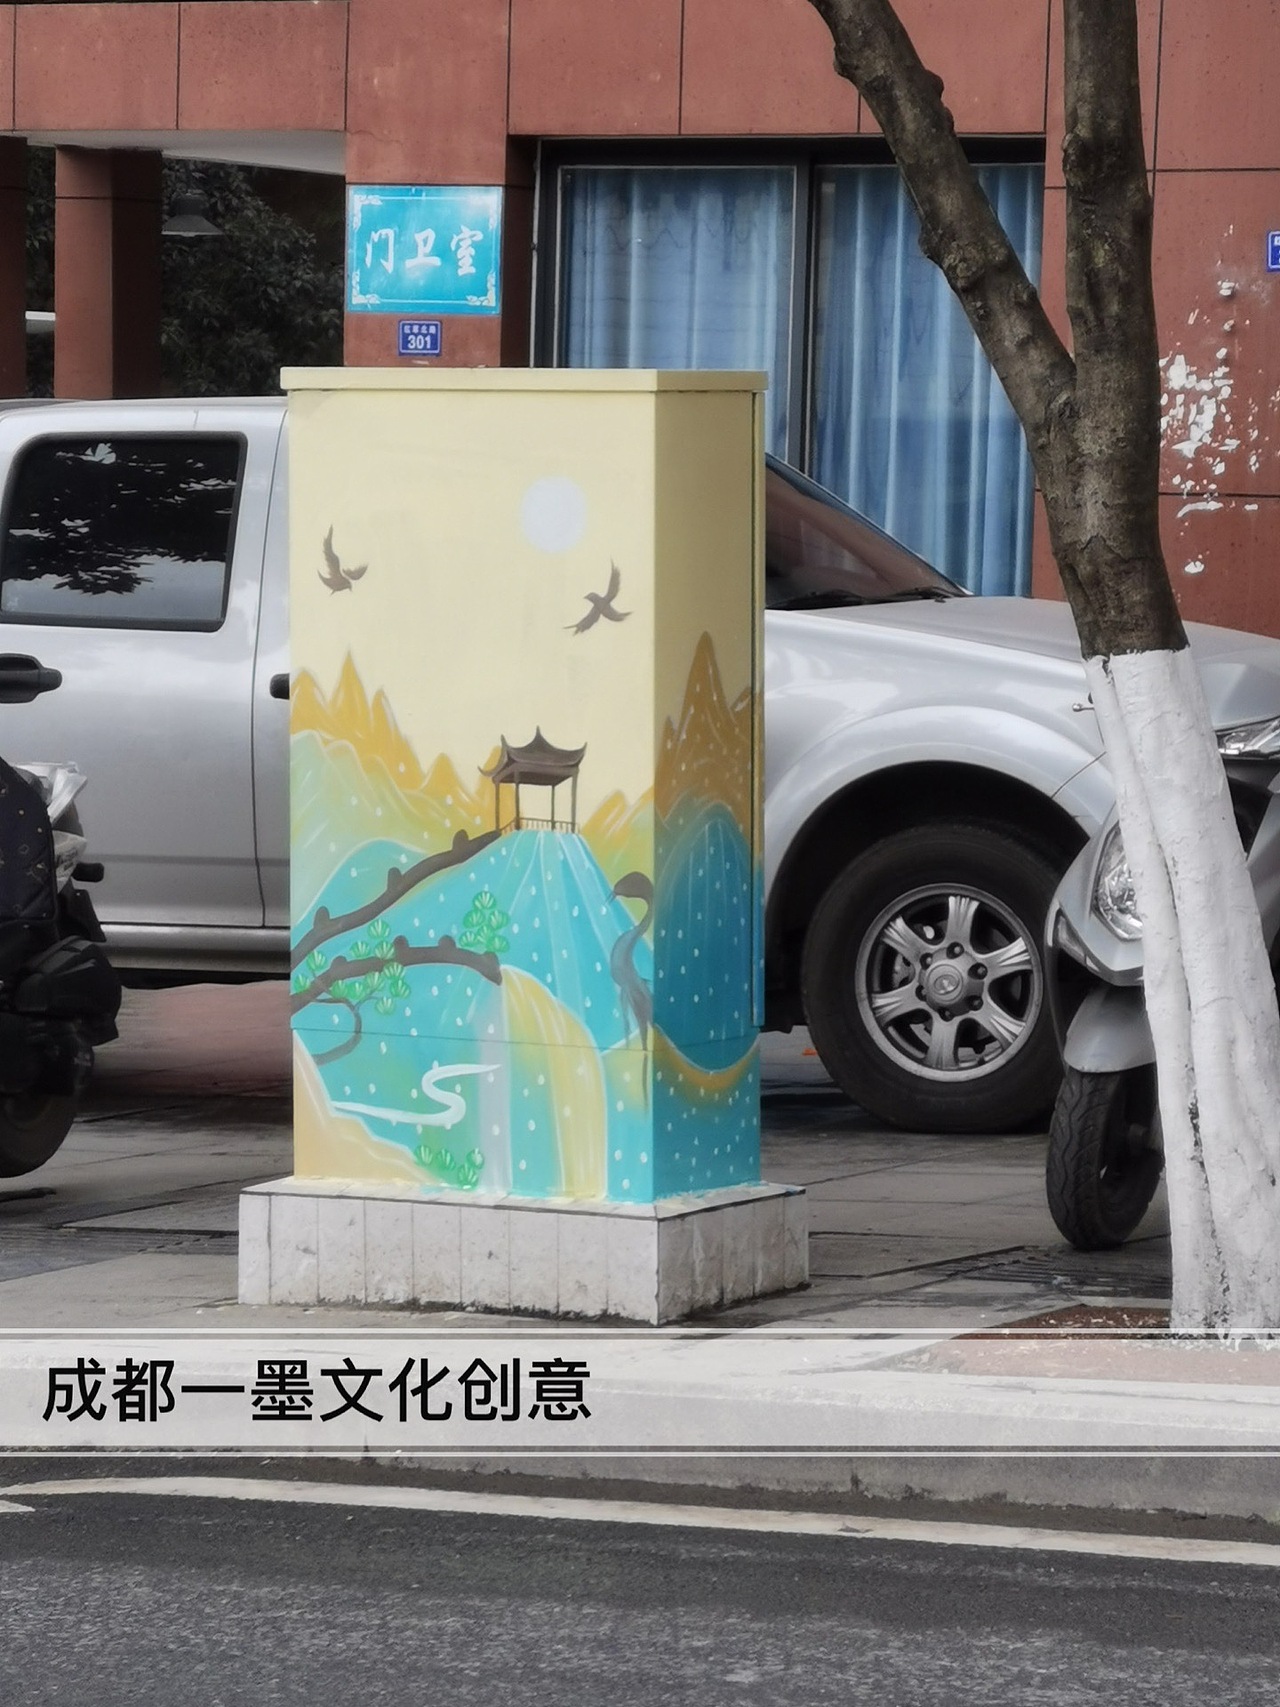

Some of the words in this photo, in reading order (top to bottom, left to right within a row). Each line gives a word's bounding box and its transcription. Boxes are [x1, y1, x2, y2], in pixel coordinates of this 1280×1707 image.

[365, 225, 484, 276] 门卫室
[407, 334, 431, 349] 301
